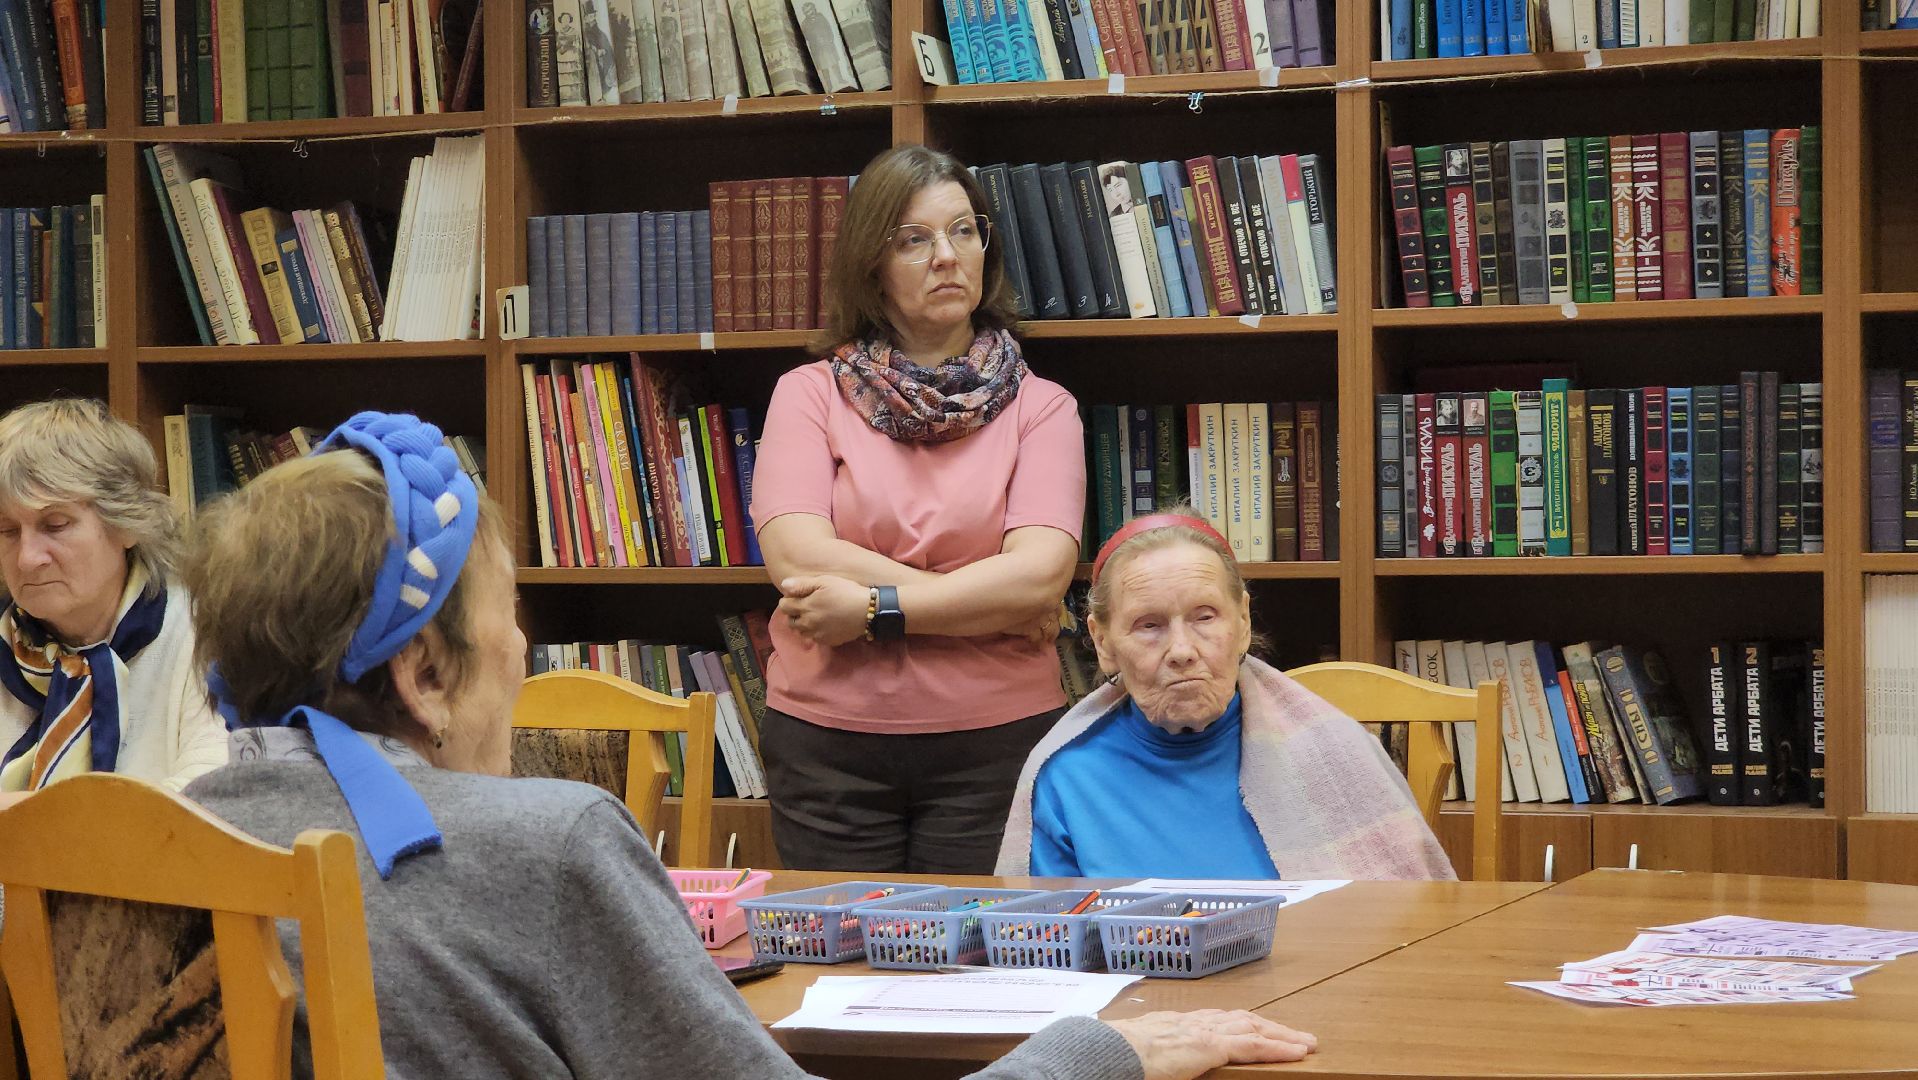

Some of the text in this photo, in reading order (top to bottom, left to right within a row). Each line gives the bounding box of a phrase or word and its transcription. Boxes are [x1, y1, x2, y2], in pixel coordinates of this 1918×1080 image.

[1254, 32, 1269, 55] 2
[1582, 34, 1589, 44] 2
[1648, 34, 1653, 43] 1
[918, 38, 935, 77] Б
[1204, 56, 1213, 67] 4
[1203, 192, 1214, 221] ГОРЬКИЙ
[1302, 168, 1318, 212] ГОРЬКИЙ
[1230, 202, 1239, 215] ВСЕ
[1234, 216, 1242, 226] ЗА
[1251, 203, 1260, 215] ВСЕ
[1256, 217, 1264, 227] ЗА
[1453, 192, 1470, 249] ПИКУЛЬ
[1237, 229, 1248, 257] ОТВЕЧАЮ
[1258, 230, 1269, 258] ОТВЕЧАЮ
[1436, 260, 1443, 268] 2
[1077, 295, 1088, 307] 3
[1269, 292, 1278, 301] Ю.
[1323, 291, 1334, 301] 15
[504, 294, 516, 334] П
[1627, 392, 1636, 413] МОРЕ
[614, 420, 630, 471] СКАЗКИ
[1419, 416, 1434, 470] ПИКУЛЬ
[1591, 413, 1603, 447] АНДРЕЙ
[1601, 413, 1614, 459] ПЛАТОНОВ
[1206, 415, 1218, 519] ВИТАЛИЙ ЗАКРУТКИН
[1230, 418, 1242, 523] ВИТАЛИЙ ЗАКРУТКИН
[1252, 415, 1262, 520] ВИТАЛИЙ ЗАКРУТКИН
[1441, 442, 1456, 499] ПИКУЛЬ
[1468, 442, 1484, 499] ПИКУЛЬ
[1550, 403, 1562, 513] ВАЛЕНТИН ПИКУЛЬ ФАВОРИТ
[648, 462, 661, 500] СКАЗКИ
[1099, 432, 1113, 527] ВЛАДИМИР ДУДИНЦЕВ
[1627, 466, 1639, 524] ПЛАТОНОВ
[1711, 646, 1721, 665] 1
[1745, 647, 1758, 666] 2
[1520, 657, 1549, 742] Анатолий РЫБАКОВ
[1576, 681, 1591, 705] помни
[1710, 666, 1729, 752] ДЕТИ АРБАТА
[1746, 667, 1764, 753] ДЕТИ АРБАТА
[1508, 706, 1521, 742] Анатолий
[1584, 709, 1604, 739] Живи
[1812, 669, 1824, 755] ДЕТИ АРБАТА
[1514, 754, 1523, 768] 2
